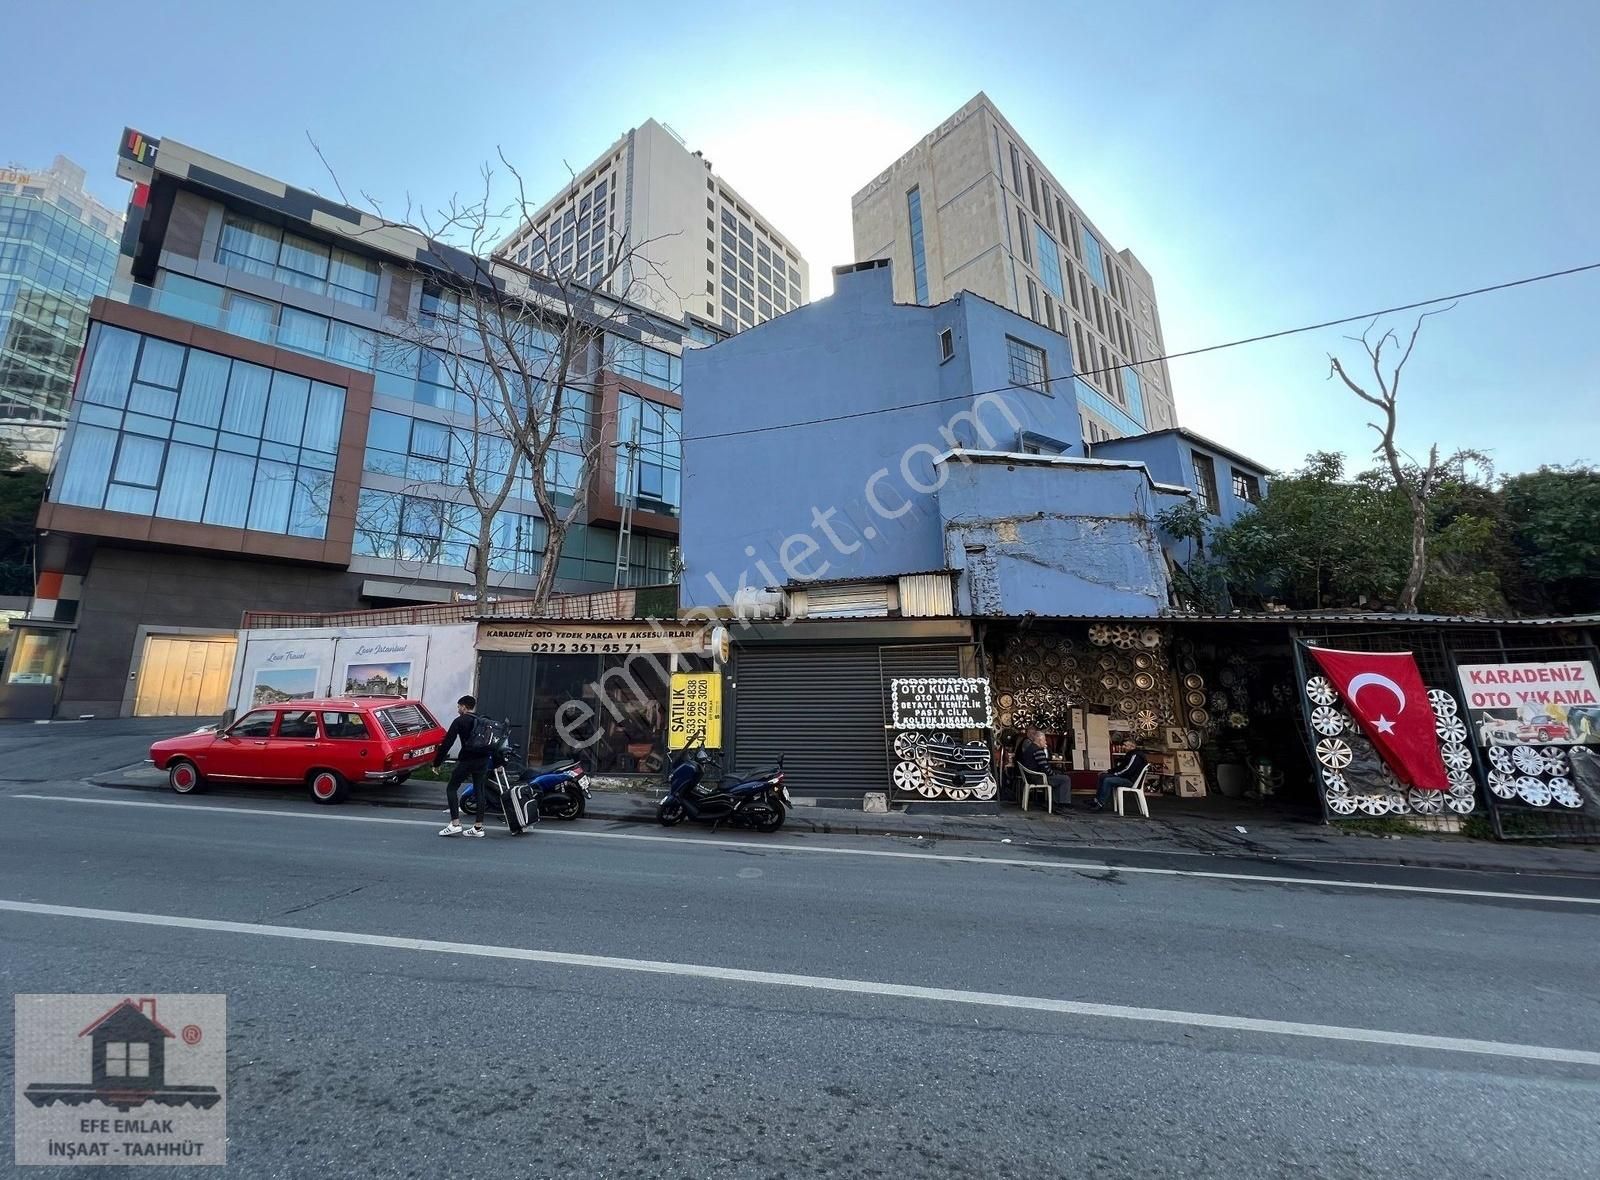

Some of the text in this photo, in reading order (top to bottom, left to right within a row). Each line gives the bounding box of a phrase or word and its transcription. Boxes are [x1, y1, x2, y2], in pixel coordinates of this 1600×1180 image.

[486, 629, 534, 638] KARADENİZ
[585, 632, 613, 640] PARÇA
[629, 631, 695, 639] AKSESUARLARI
[531, 643, 641, 653] 0212 361 45 71
[1469, 664, 1585, 685] KARADENİZ
[687, 679, 697, 699] 4838
[698, 679, 708, 699] 3020
[901, 681, 979, 694] OTO KUAFÖR
[900, 699, 981, 709] DETAYLI TEMİZLİK
[1471, 689, 1597, 707] OTO YIKAMA
[671, 688, 685, 732] SATILIK
[686, 701, 696, 717] 666
[697, 701, 707, 717] 225
[947, 707, 968, 716] CİLA
[686, 719, 696, 734] 533
[903, 716, 974, 724] KOLTUK YIKAMA
